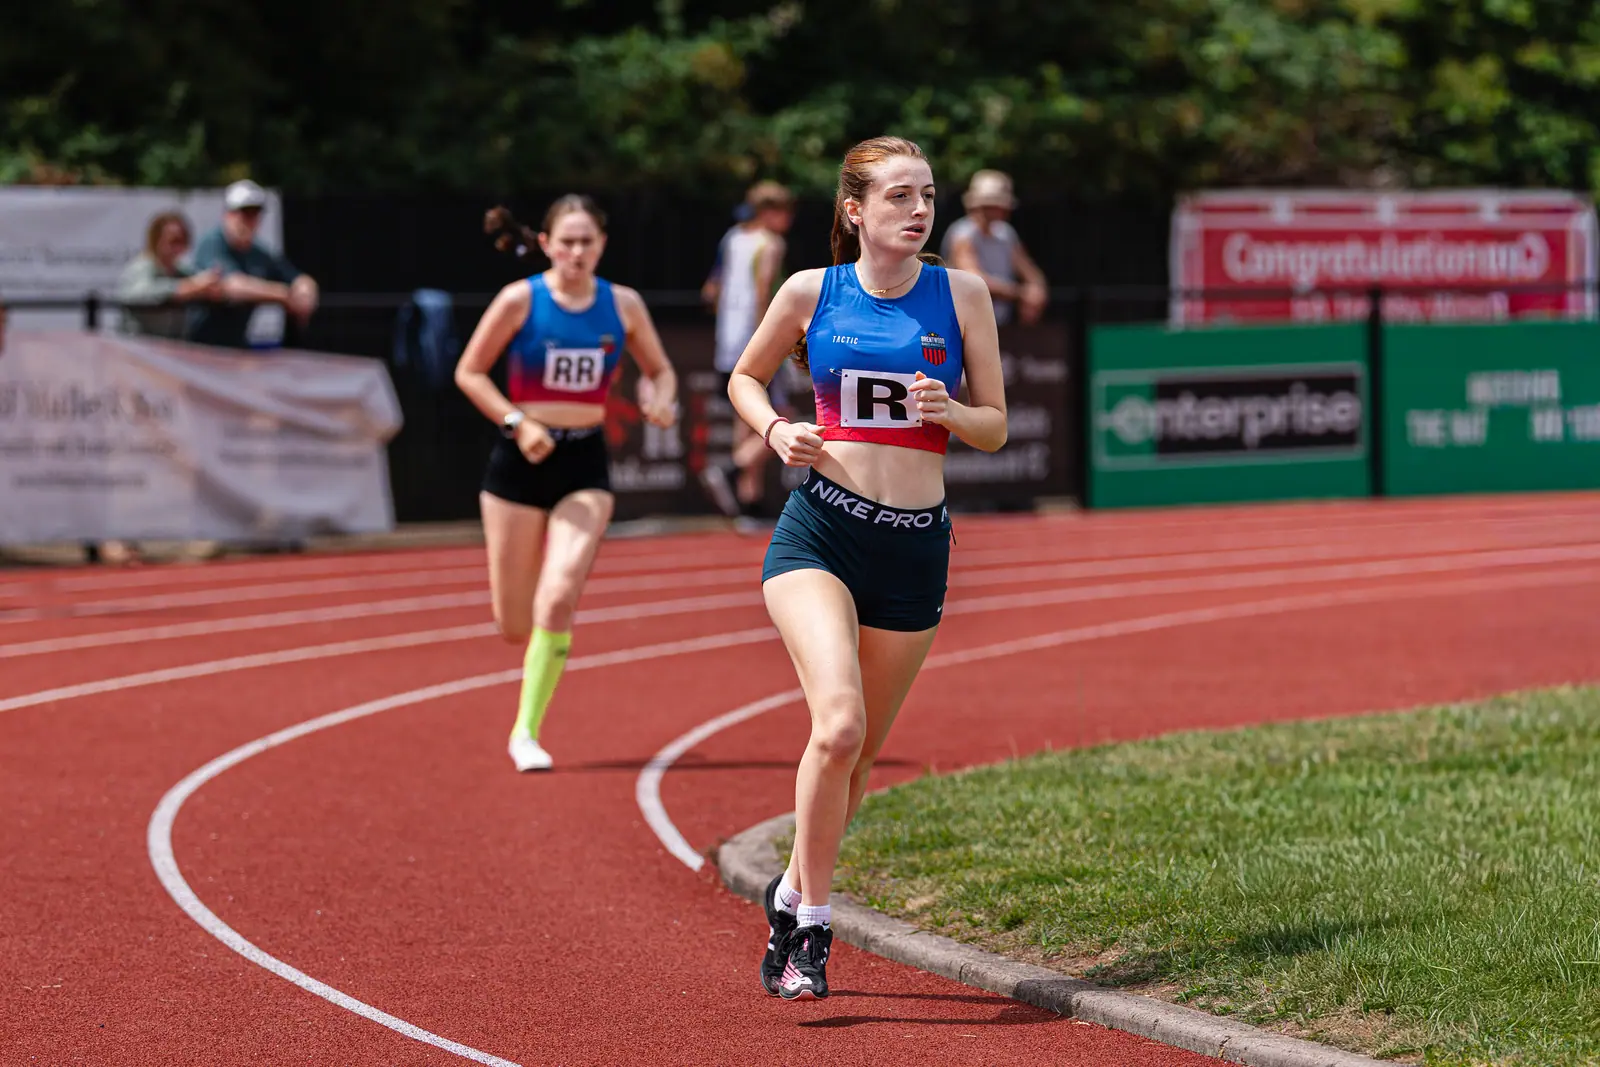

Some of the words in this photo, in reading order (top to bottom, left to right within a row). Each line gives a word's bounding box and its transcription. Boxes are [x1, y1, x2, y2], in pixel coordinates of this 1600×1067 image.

[832, 335, 859, 345] TACTIC
[920, 335, 945, 344] BRENTWOOD
[553, 356, 594, 383] RR
[857, 377, 909, 421] R
[1108, 380, 1361, 449] enterprise
[810, 480, 875, 520] NIKE
[874, 509, 933, 528] PRO
